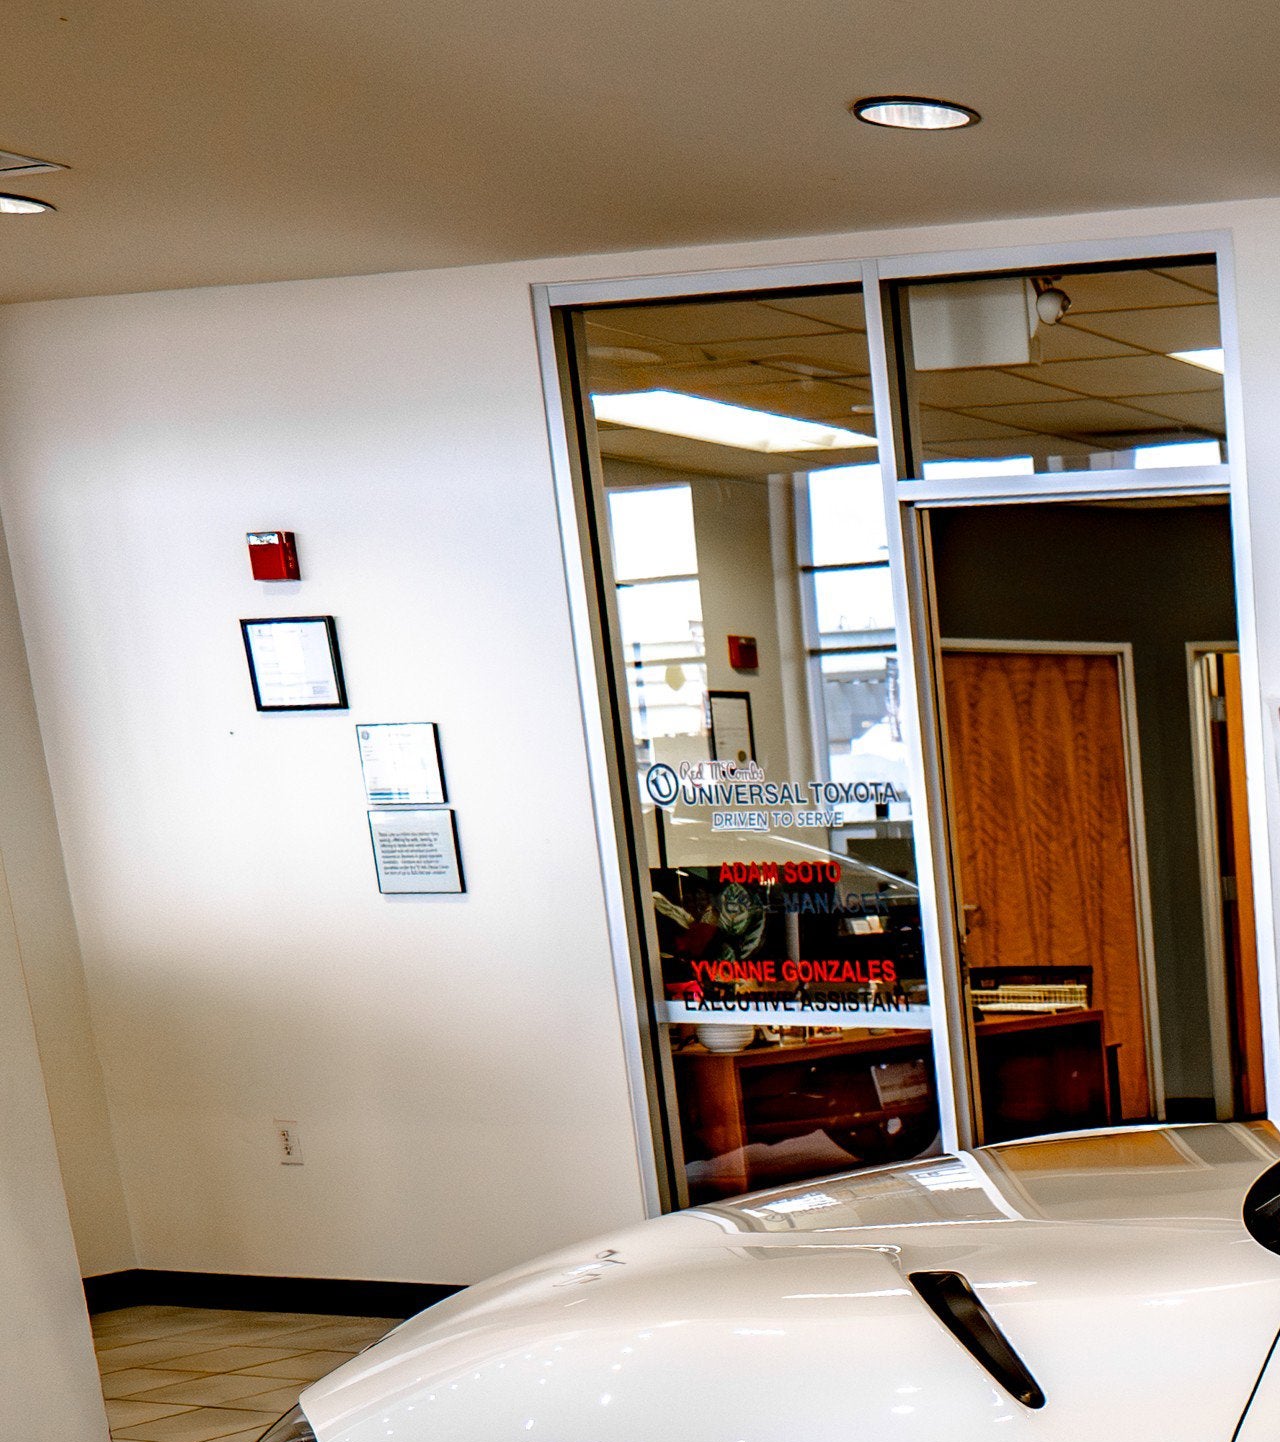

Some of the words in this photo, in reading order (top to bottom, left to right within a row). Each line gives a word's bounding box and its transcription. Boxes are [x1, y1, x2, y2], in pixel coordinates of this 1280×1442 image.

[682, 783, 808, 806] UNIVERSAL
[810, 781, 899, 804] TOYOTA
[713, 811, 769, 827] DRIVEN
[773, 811, 794, 827] TO
[797, 811, 843, 827] SERVE
[719, 861, 778, 883] ADAM
[784, 860, 842, 884] SOTO
[783, 891, 889, 915] MANAGER
[691, 959, 777, 983] YVONNE
[782, 959, 897, 984] GONZALES
[684, 990, 796, 1012] EXECUTIVE
[799, 990, 912, 1013] ASSISTANT
